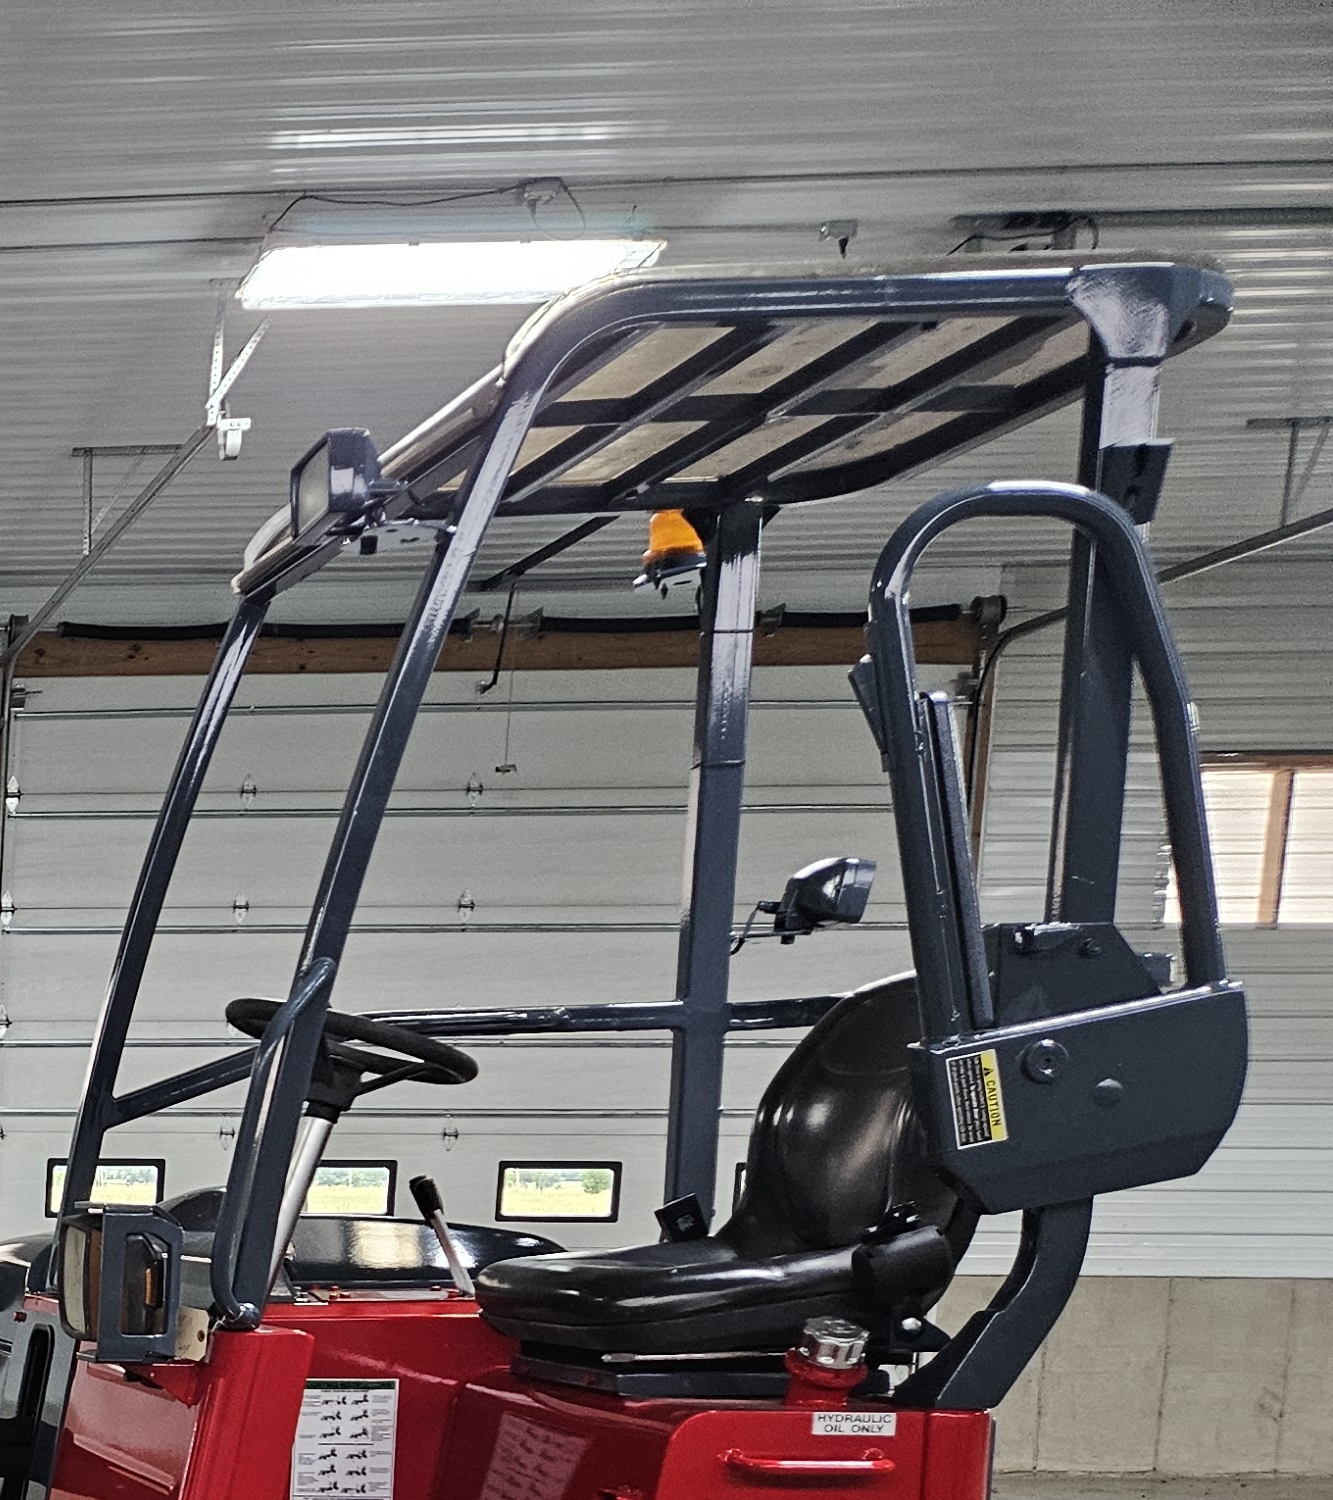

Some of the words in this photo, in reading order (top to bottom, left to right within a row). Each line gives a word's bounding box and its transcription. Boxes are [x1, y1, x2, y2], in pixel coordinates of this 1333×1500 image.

[986, 1080, 1002, 1126] CAUTION
[817, 1414, 892, 1424] HYDRAULIC
[823, 1424, 845, 1433] OIL
[851, 1424, 885, 1433] ONLY
